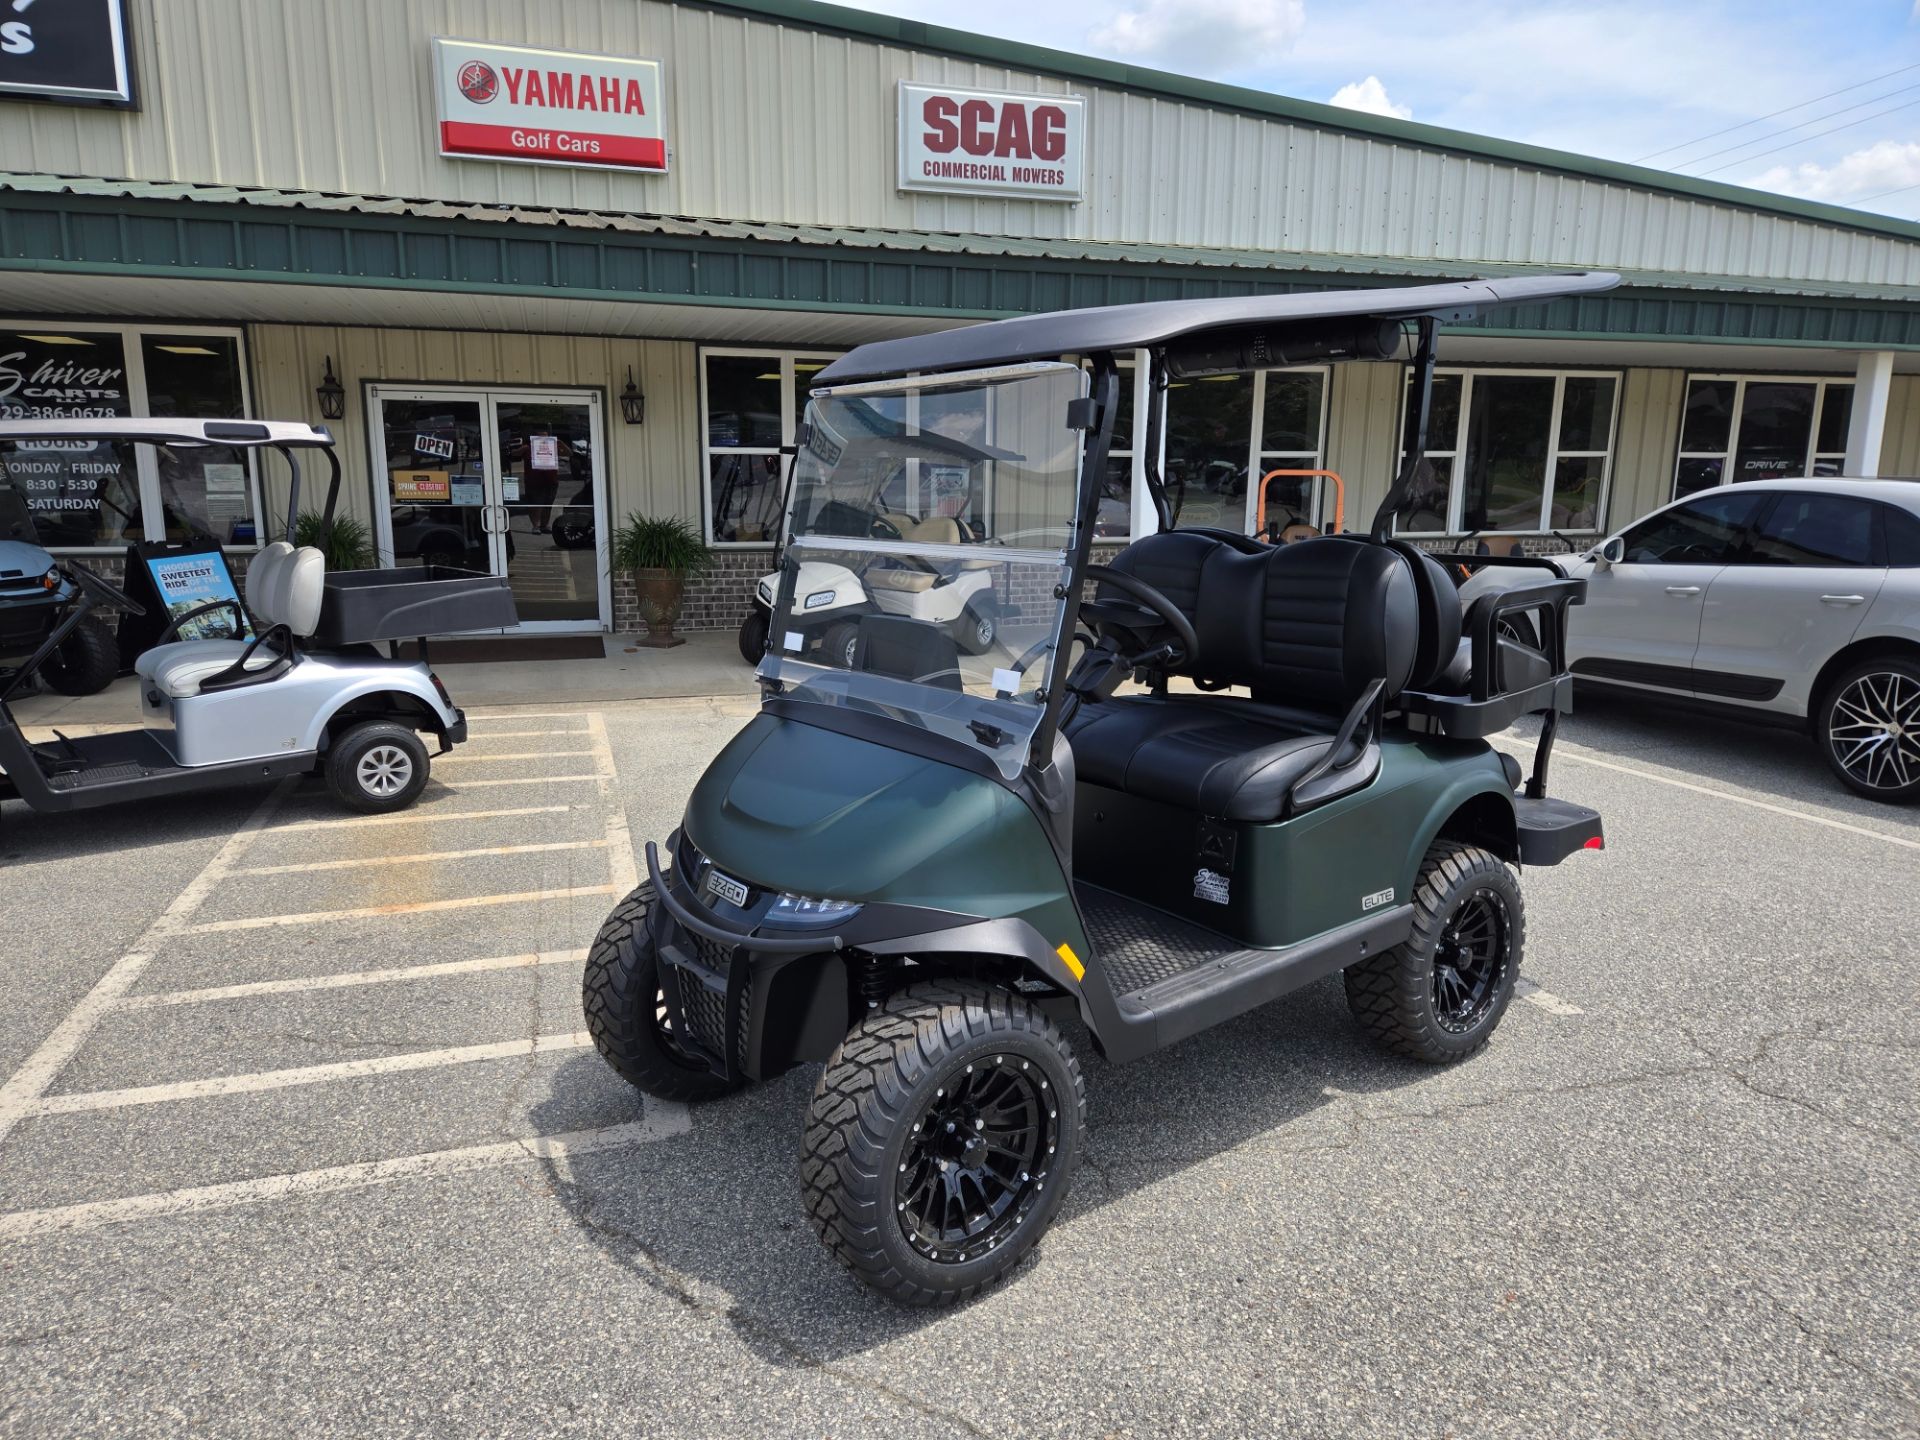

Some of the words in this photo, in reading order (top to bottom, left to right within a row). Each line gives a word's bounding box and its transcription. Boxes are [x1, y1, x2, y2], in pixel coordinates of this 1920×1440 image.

[501, 67, 645, 115] YAMAHA
[923, 96, 1066, 161] SCAG
[511, 130, 550, 149] Golf
[557, 134, 600, 153] Cars
[923, 160, 1006, 182] COMMERCIAL
[1012, 166, 1064, 185] MOWERS
[0, 352, 121, 397] Shiver
[23, 388, 121, 399] CARTS
[418, 436, 451, 456] OPEN
[6, 463, 61, 474] ONDAY
[72, 463, 121, 474] FRIDAY
[26, 479, 56, 490] 8:30
[67, 480, 97, 490] 5:30
[27, 499, 100, 510] SATURDAY
[161, 568, 211, 581] SWEETEST
[164, 580, 188, 590] RIDE
[709, 876, 745, 901] EZGO
[1364, 890, 1393, 908] ELITE
